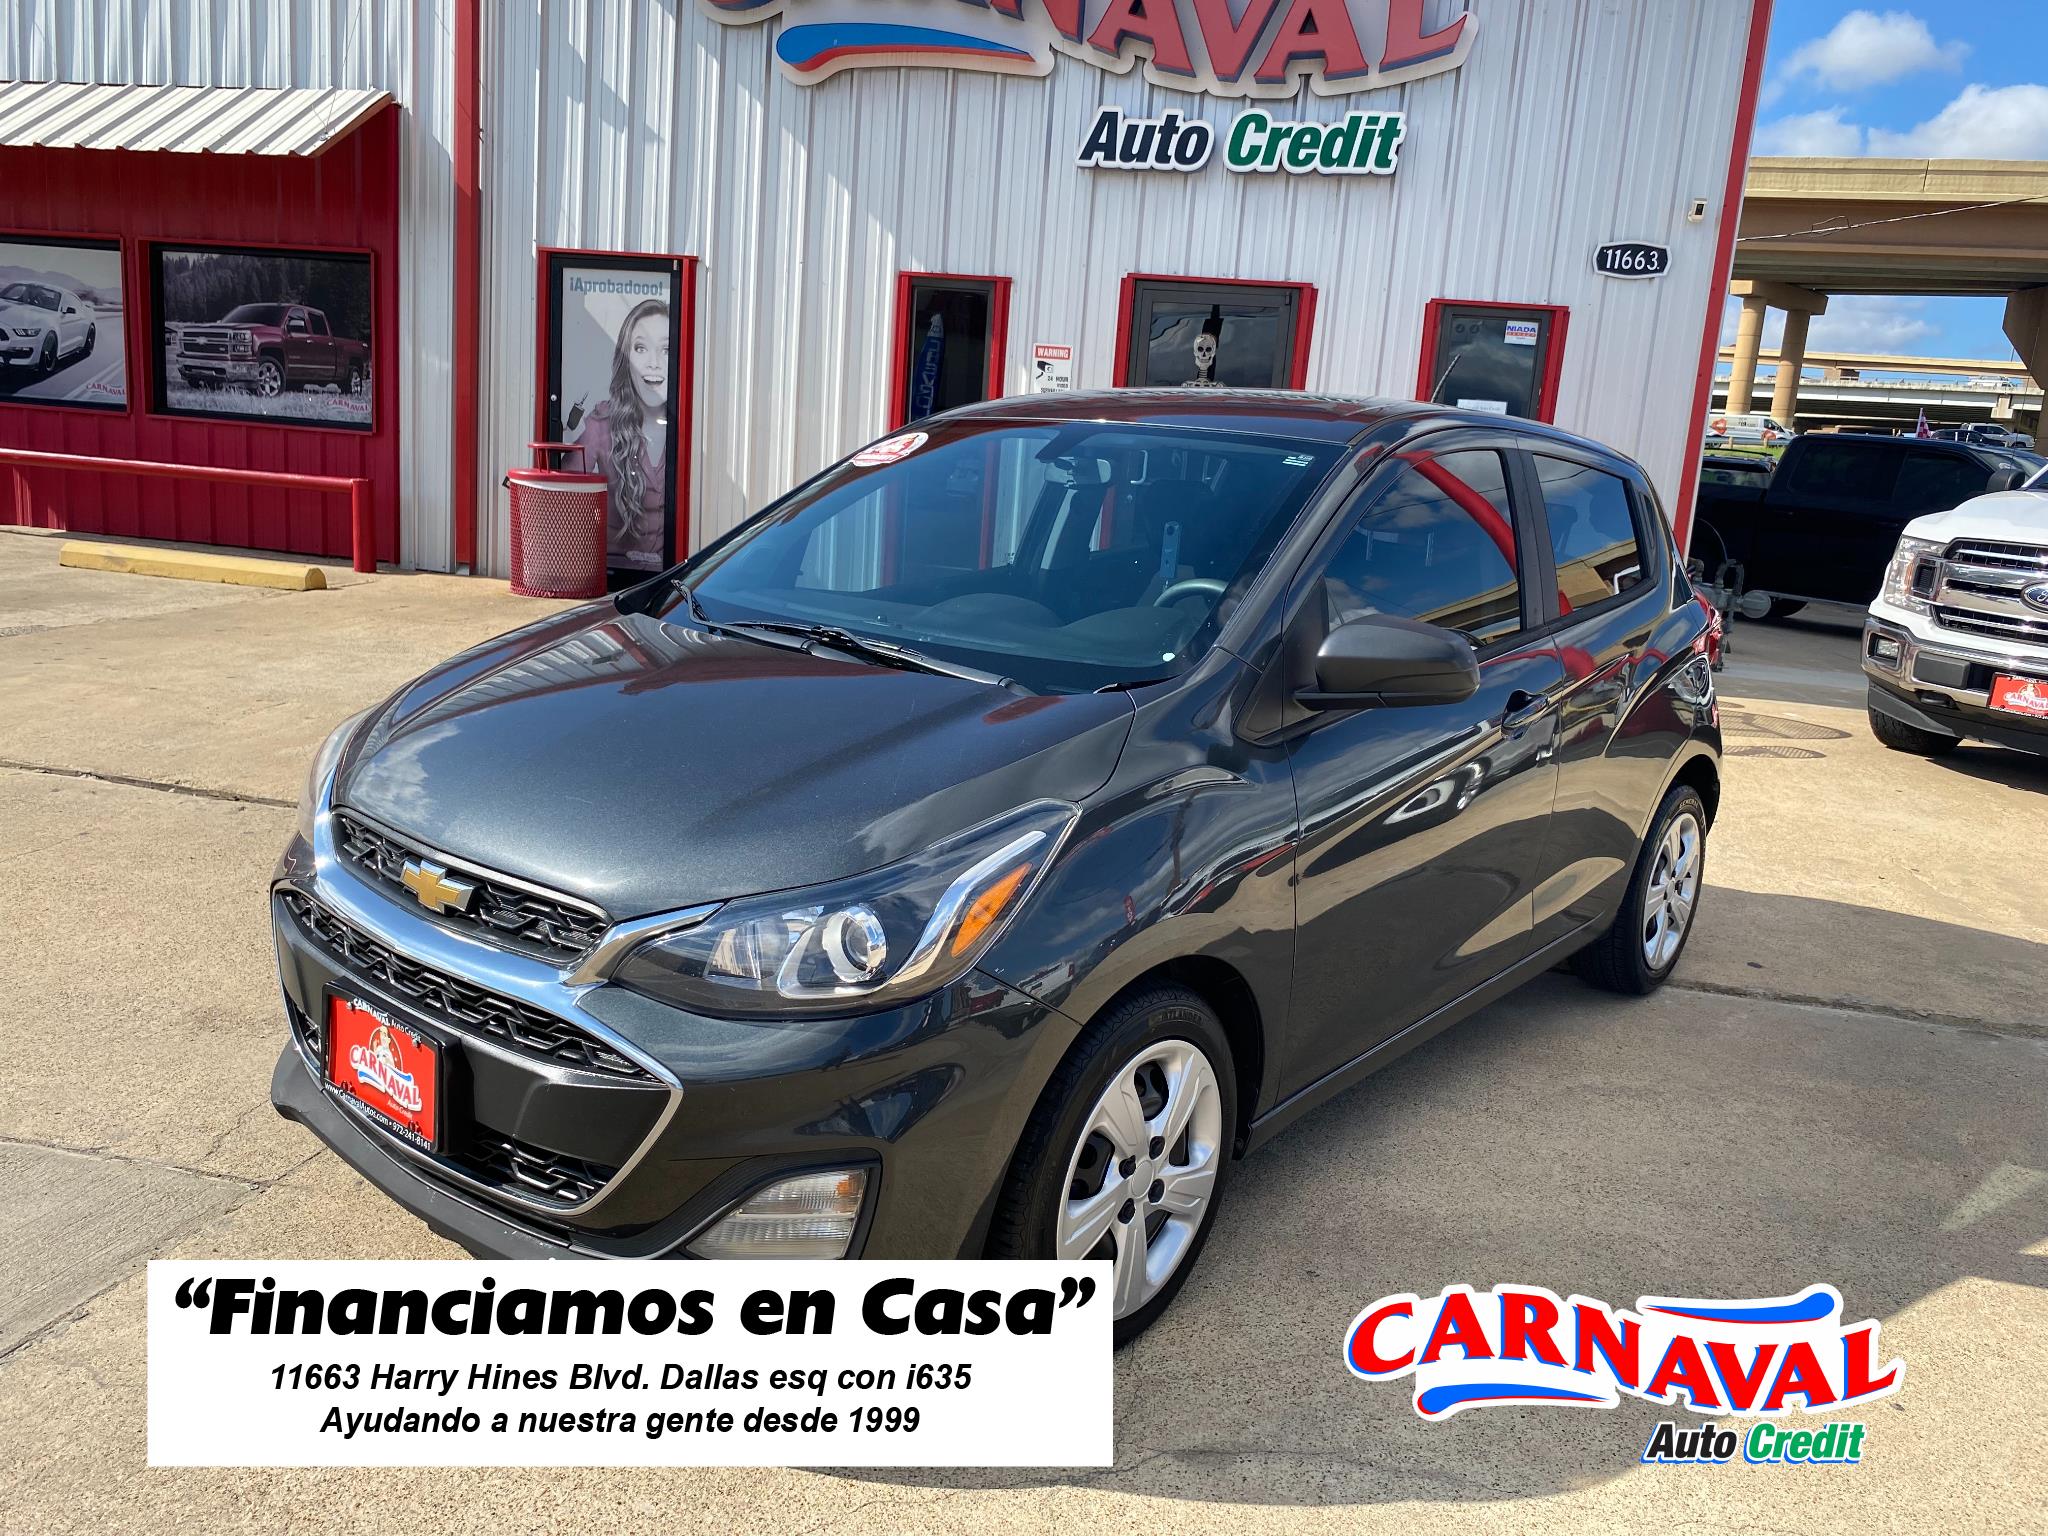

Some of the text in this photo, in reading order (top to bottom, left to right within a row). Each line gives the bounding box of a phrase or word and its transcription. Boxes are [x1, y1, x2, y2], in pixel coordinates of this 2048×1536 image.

[1079, 110, 1404, 174] Auto Credit
[1605, 249, 1659, 271] 11663
[569, 277, 664, 297] ¡Aprobadooo!
[1506, 325, 1537, 334] NIADA
[1037, 347, 1070, 359] WARNING
[86, 382, 126, 396] CARNAVAL
[326, 399, 369, 413] CARNAVAL
[2003, 691, 2048, 710] CARNAVA
[350, 1045, 422, 1107] CARNAVAL
[392, 1121, 431, 1151] 972-241-8141
